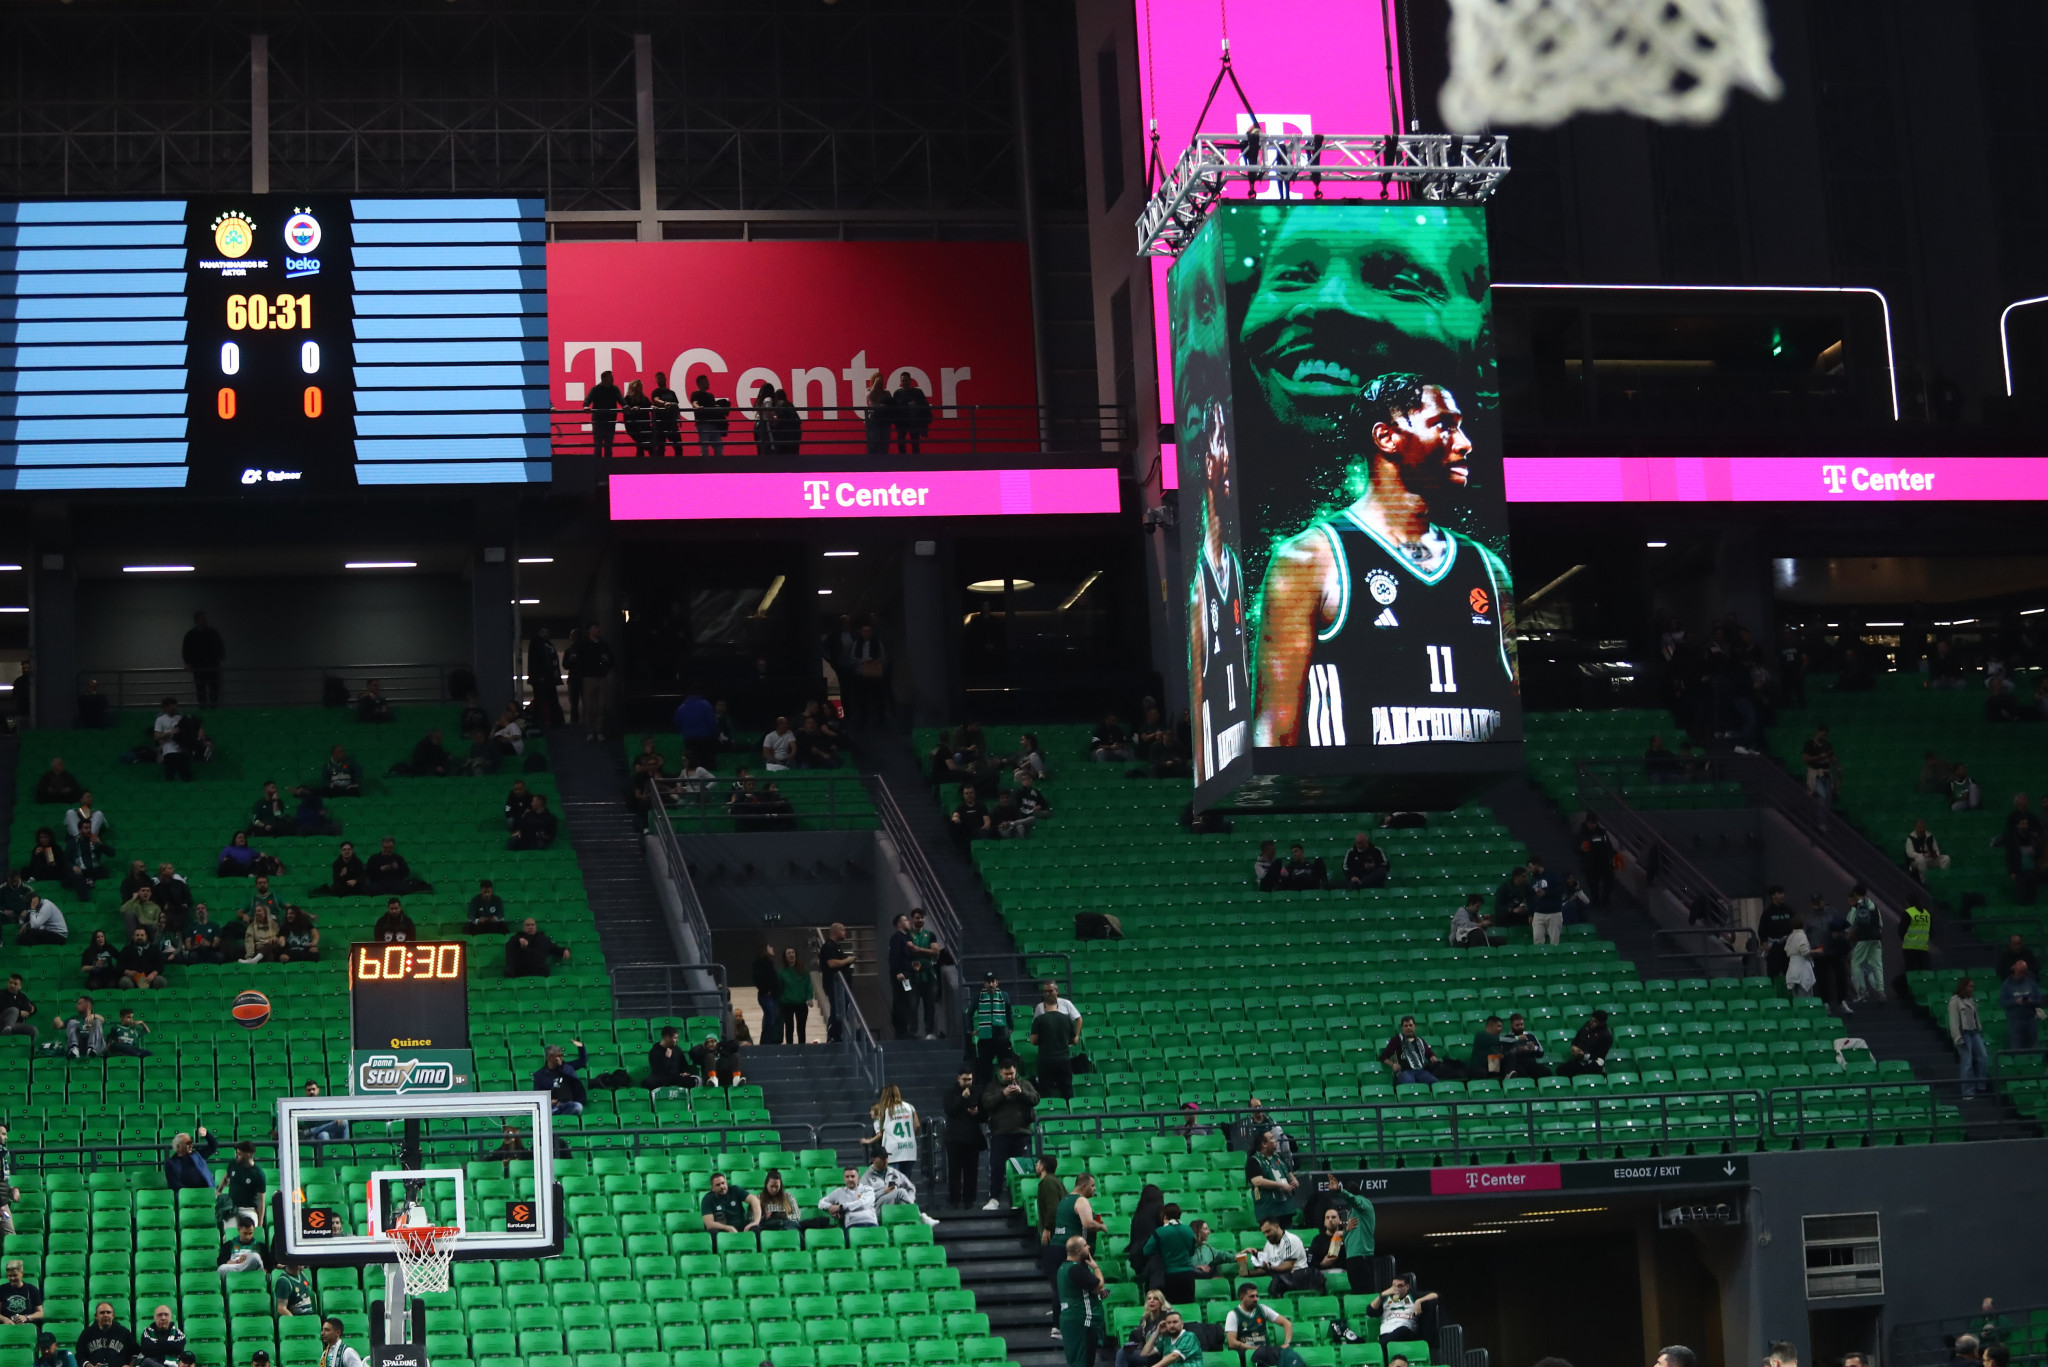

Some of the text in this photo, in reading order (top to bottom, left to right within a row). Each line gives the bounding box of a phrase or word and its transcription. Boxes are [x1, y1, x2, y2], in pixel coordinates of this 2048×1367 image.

[285, 257, 321, 272] beko
[226, 293, 311, 331] 60:31
[221, 341, 240, 375] 0
[301, 341, 320, 374] 0
[217, 387, 236, 420] 0
[303, 386, 323, 418] 0
[1850, 467, 1935, 493] Center
[834, 482, 929, 508] Center
[1426, 645, 1457, 693] 11
[390, 1037, 432, 1049] Quince
[372, 1059, 393, 1068] pame
[893, 1121, 912, 1139] 41
[1480, 1171, 1527, 1188] Center
[1613, 1166, 1651, 1179] ΕΞΟΔΟΣ
[1660, 1165, 1682, 1178] EXIT
[1366, 1179, 1388, 1190] EXIT
[382, 1359, 418, 1367] SPALDING
